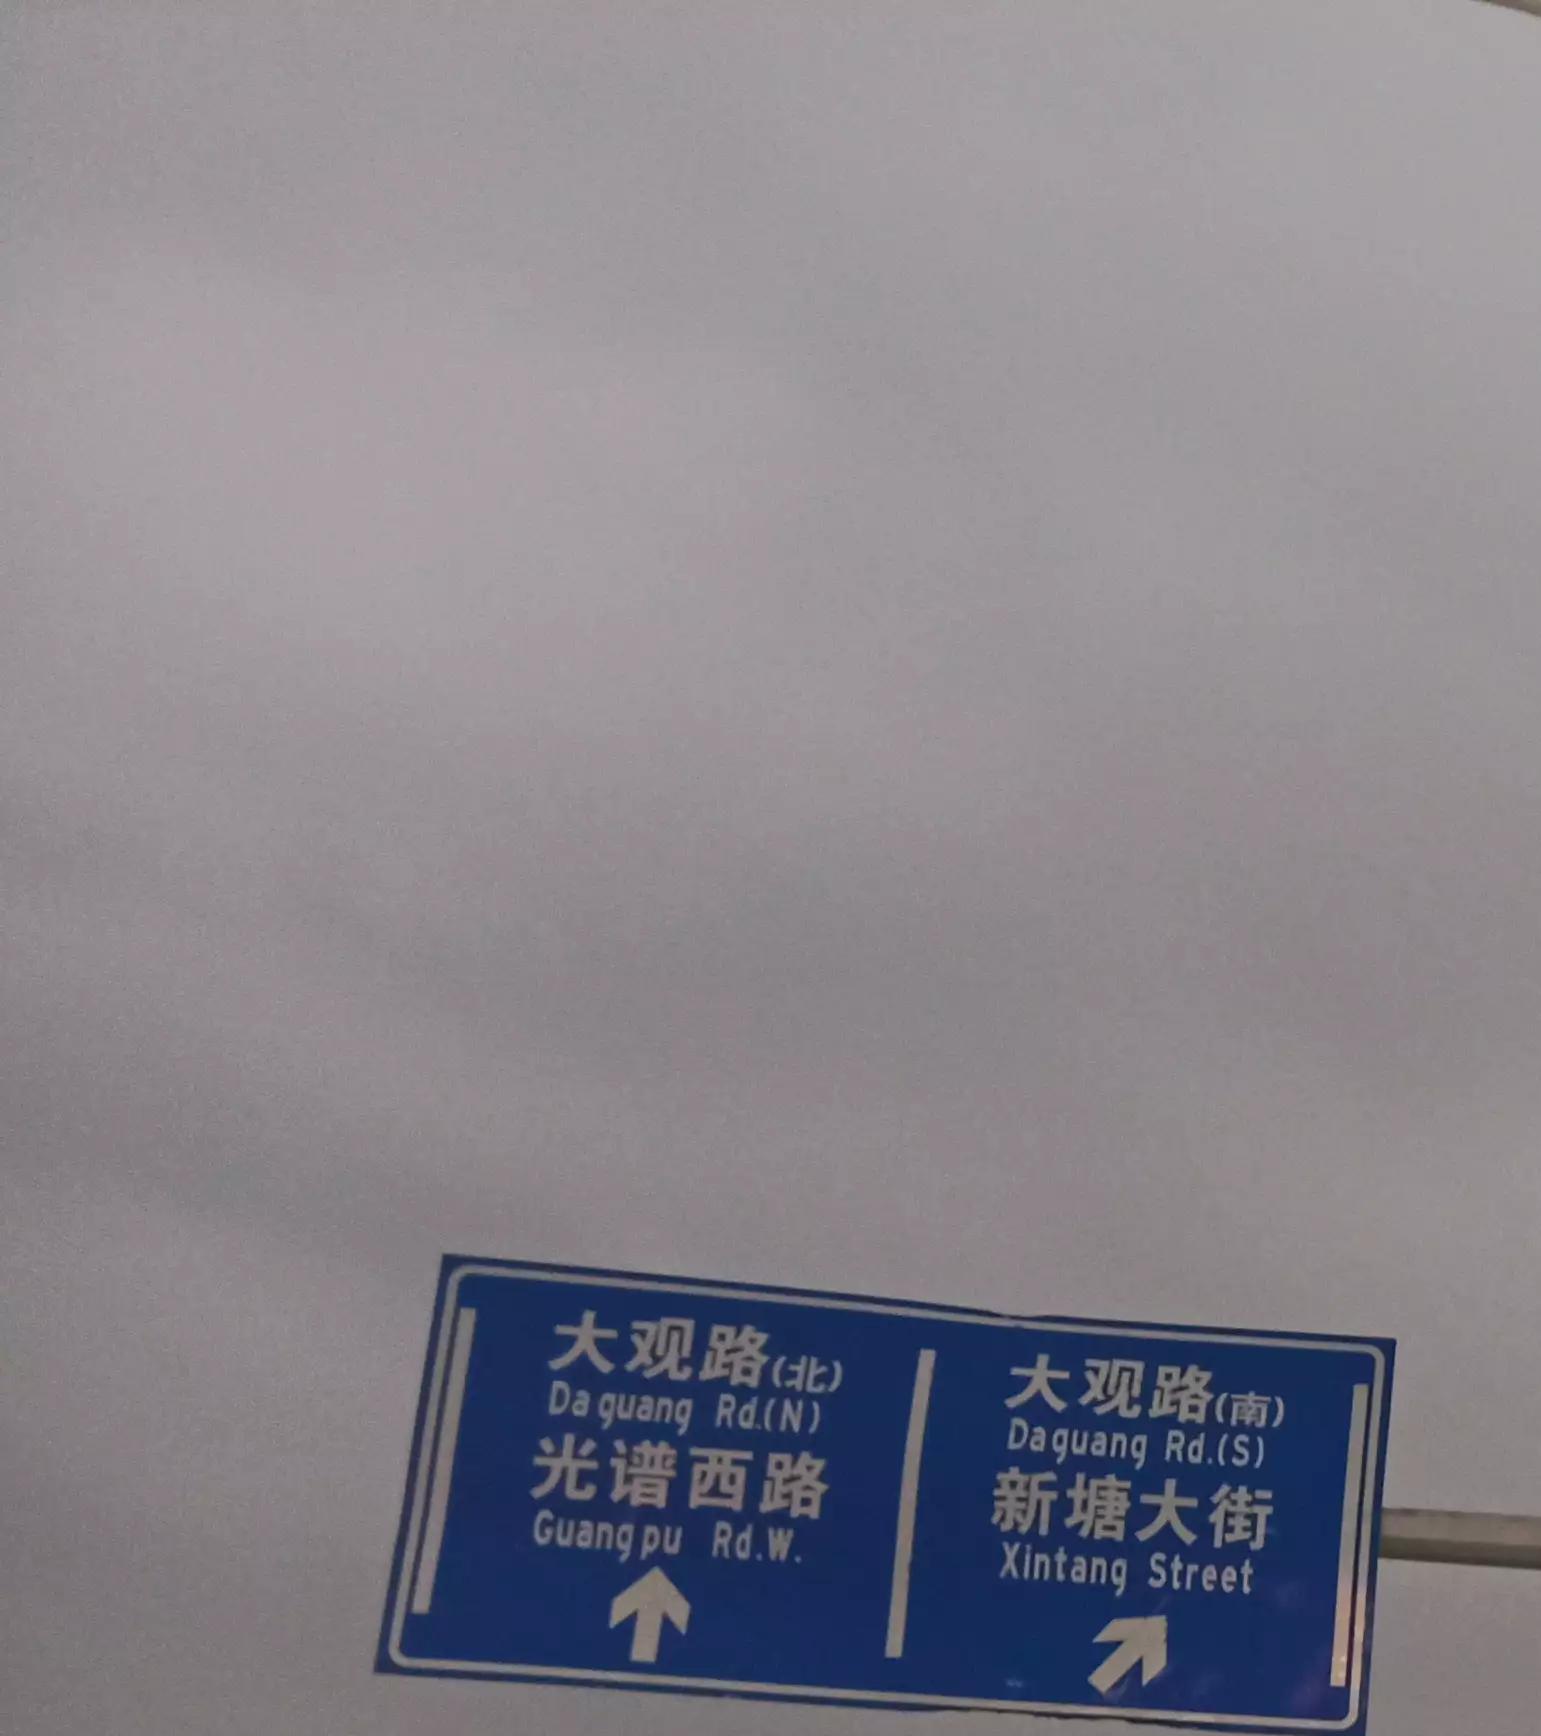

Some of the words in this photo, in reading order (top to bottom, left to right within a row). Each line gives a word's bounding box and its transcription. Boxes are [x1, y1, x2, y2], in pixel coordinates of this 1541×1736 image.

[530, 1433, 829, 1520] 光谱西路
[1007, 1418, 1148, 1470] Daguang
[991, 1466, 1275, 1552] 新塘大街
[1000, 1541, 1128, 1598] Xintang
[1147, 1552, 1255, 1595] Street
